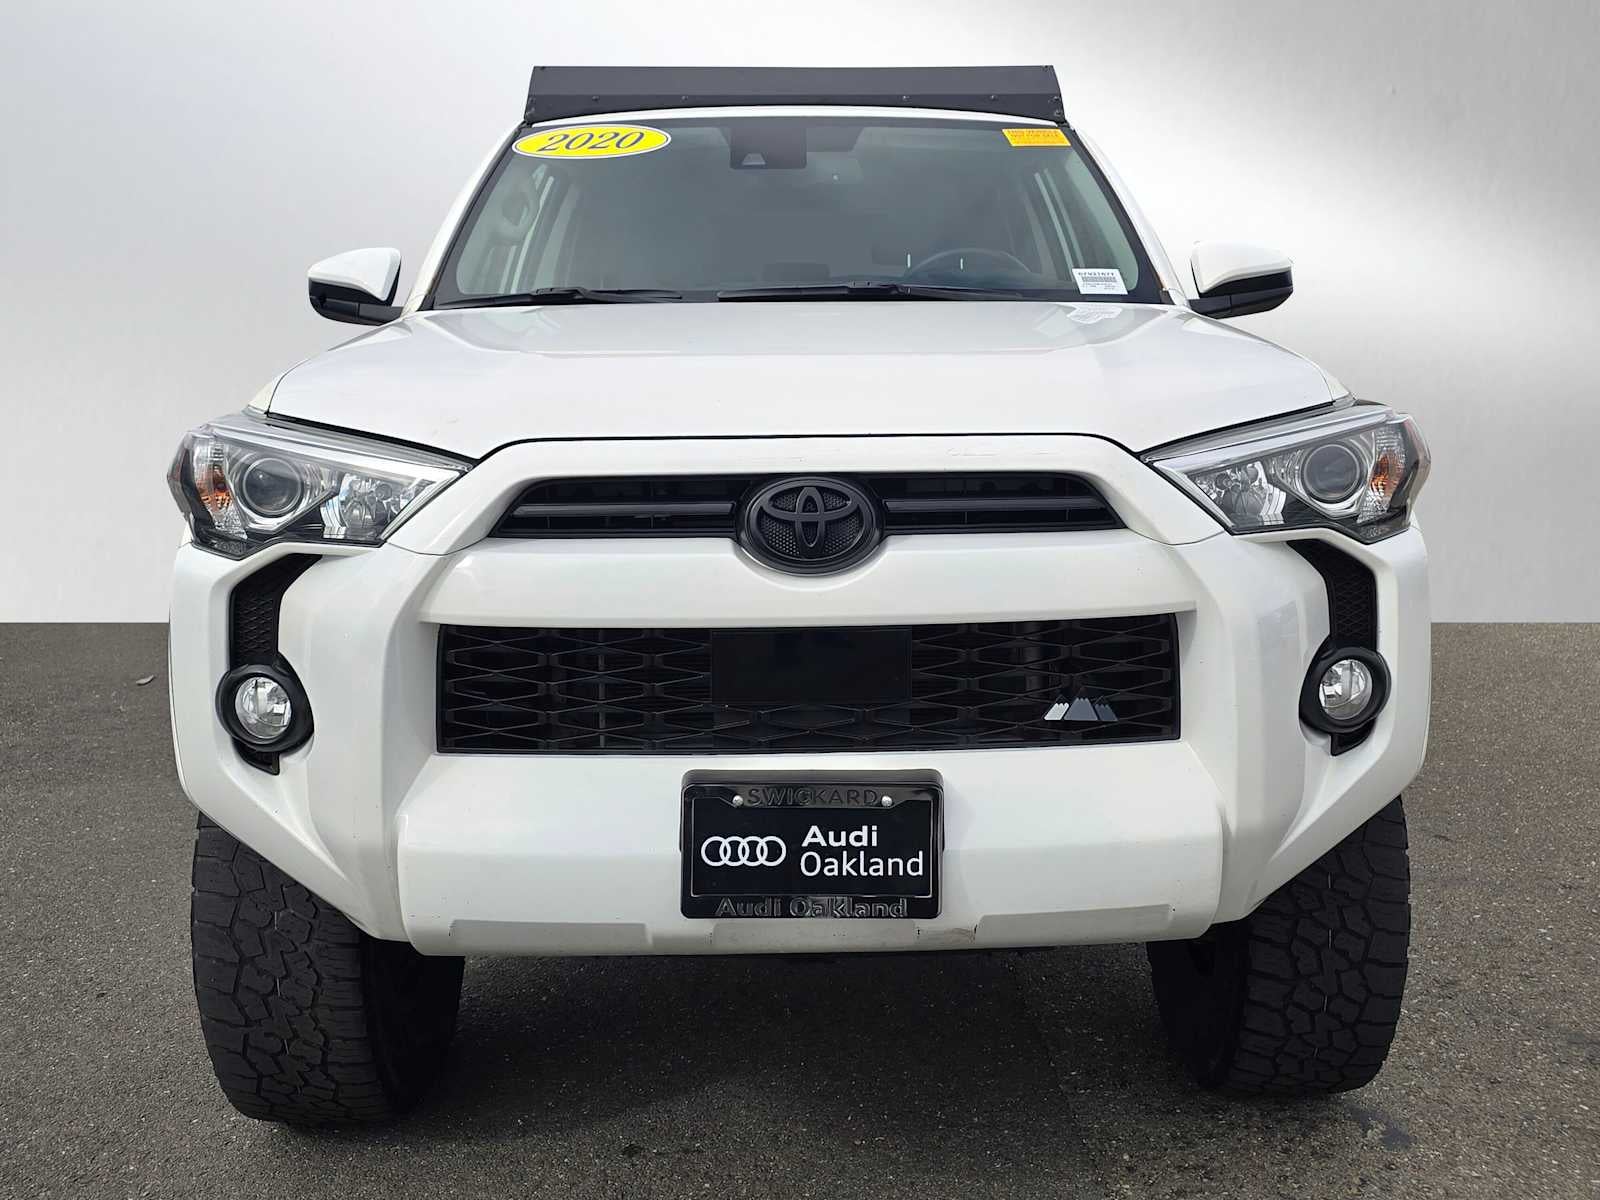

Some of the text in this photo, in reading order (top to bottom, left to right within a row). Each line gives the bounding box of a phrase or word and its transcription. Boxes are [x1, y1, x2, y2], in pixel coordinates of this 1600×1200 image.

[538, 131, 645, 152] 2020
[748, 787, 878, 807] SWICKARD
[801, 825, 878, 847] Audi
[800, 851, 924, 876] Oakland
[715, 897, 908, 918] Audi Oakland
